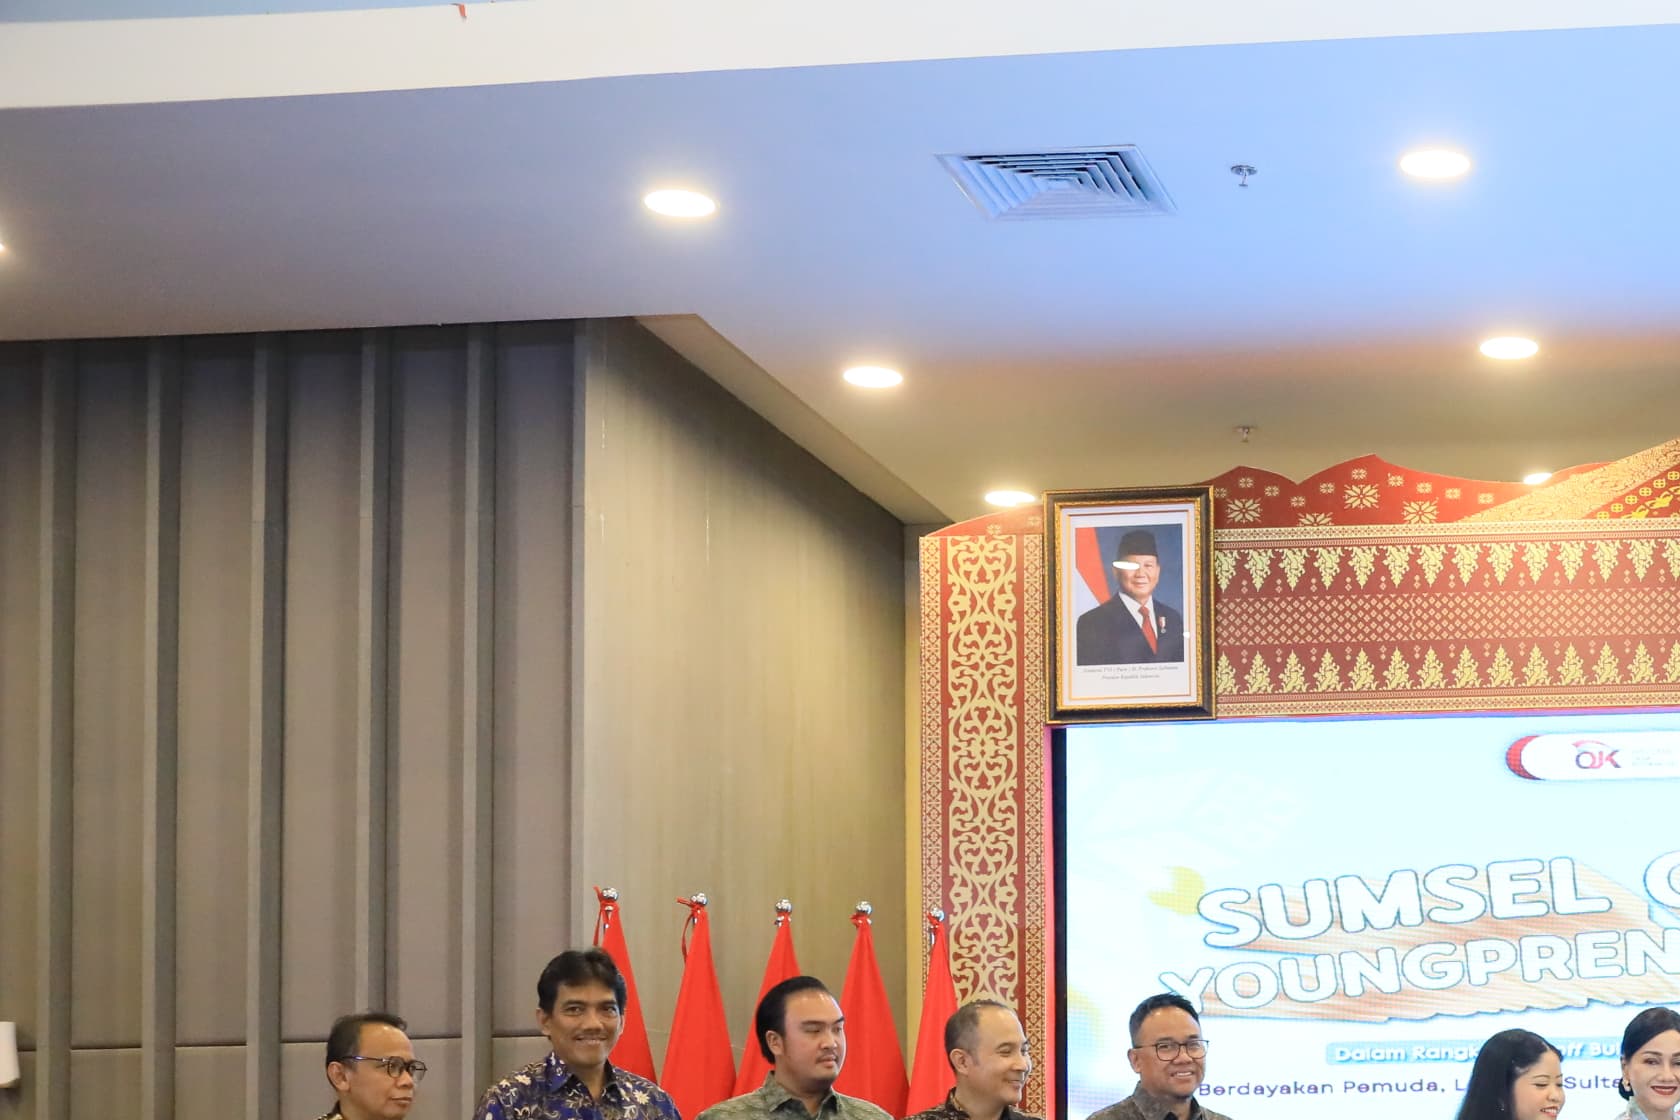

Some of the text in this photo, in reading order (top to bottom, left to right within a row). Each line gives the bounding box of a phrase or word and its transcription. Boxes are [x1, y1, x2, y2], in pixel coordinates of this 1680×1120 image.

[1197, 856, 1612, 949] SUMSEL
[1335, 1045, 1406, 1062] Dalam
[1414, 1043, 1480, 1063] Rangk
[1199, 1080, 1334, 1098] Berdayakan
[1343, 1078, 1446, 1095] Pemuda,
[1563, 1075, 1620, 1089] Sulta
